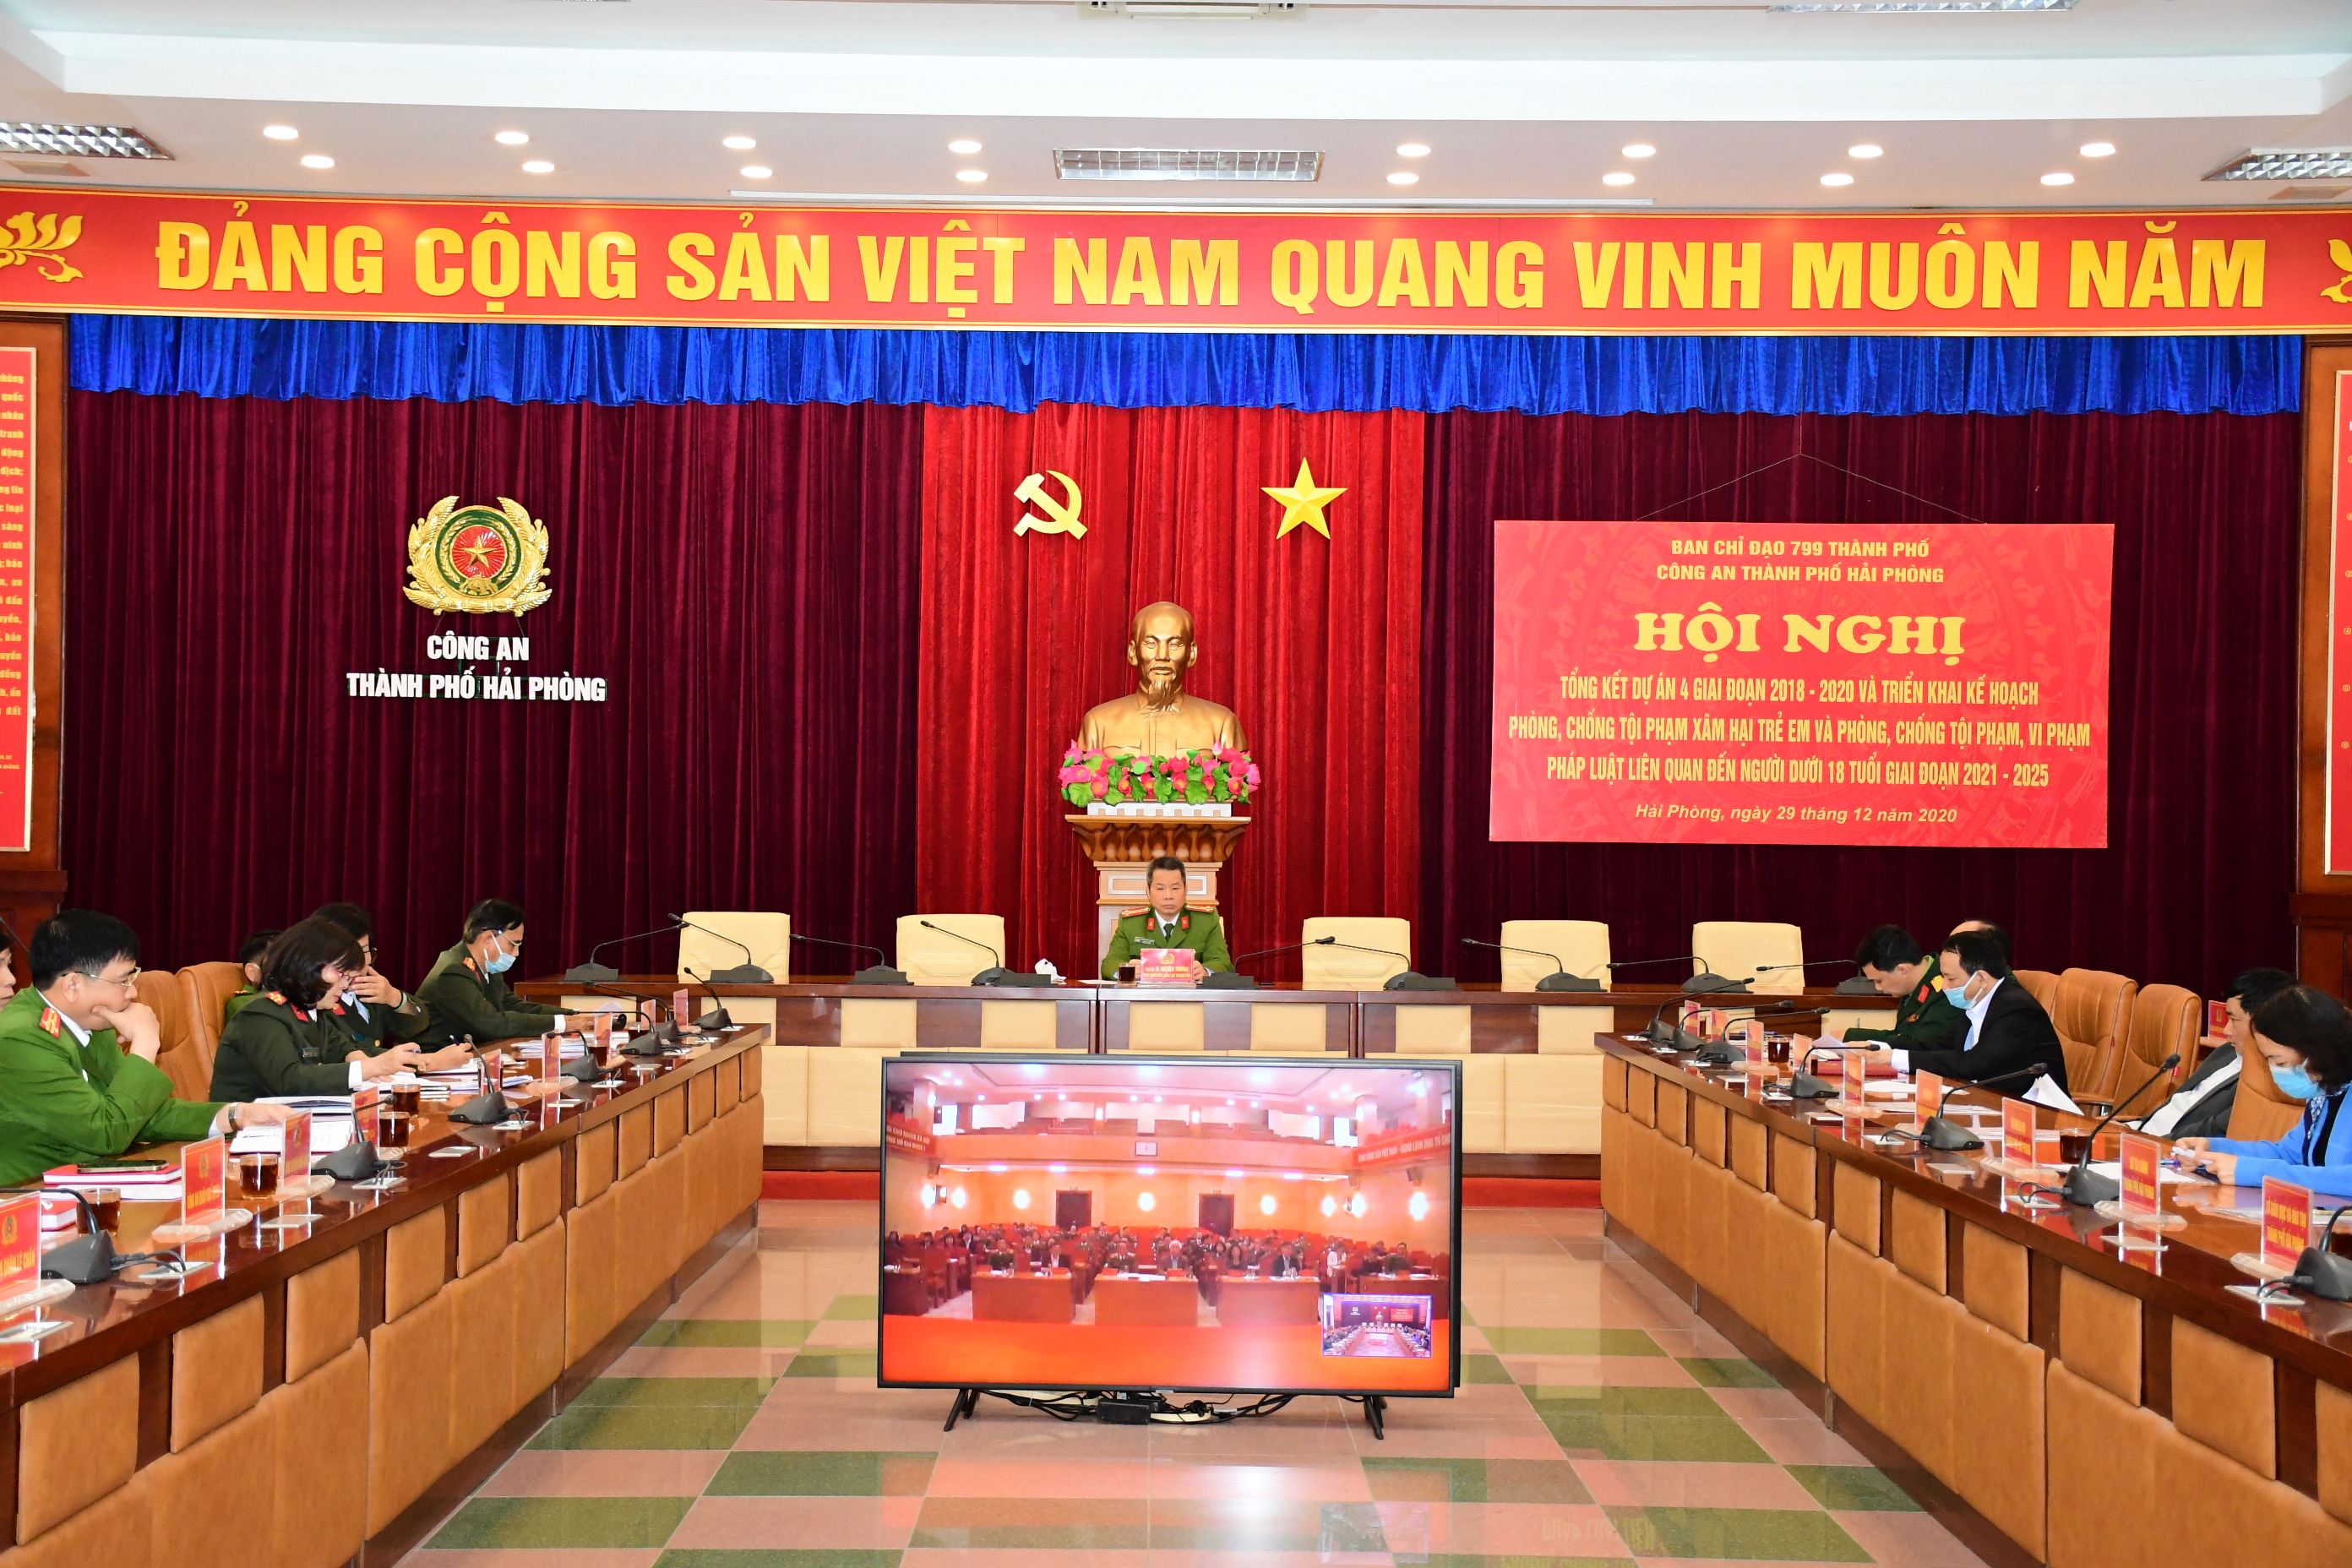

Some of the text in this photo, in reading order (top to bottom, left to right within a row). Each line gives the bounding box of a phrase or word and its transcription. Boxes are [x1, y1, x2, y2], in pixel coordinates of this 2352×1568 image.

[155, 200, 2266, 318] ĐẢNG CỘNG SẢN VIỆT NAM QUANG VINH MUÔN NĂM
[0, 373, 24, 384] hòng
[2, 392, 24, 401] quốc
[1672, 536, 1929, 558] BAN CHỈ ĐẠO 799 THÀNH PHỐ
[1657, 562, 1943, 582] CÔNG AN THÀNH PHỐ HẢI PHÒNG
[427, 630, 530, 661] CÔNG AN
[1634, 602, 1965, 666] HỘI NGHỊ
[346, 665, 607, 702] THÀNH PHỐ HẢI PHÒNG
[1560, 667, 1598, 699] TỔNG
[1602, 669, 1628, 699] KẾT
[1632, 674, 1653, 705] DỰ
[1656, 672, 1675, 700] ÁN
[1680, 678, 1689, 700] 4
[1693, 678, 1722, 700] GIAI
[1726, 678, 1766, 705] ĐOẠN
[1770, 678, 1805, 701] 2018
[1819, 679, 1854, 702] 2020
[1859, 675, 1877, 702] VÀ
[1881, 671, 1923, 703] TRIỂN
[1928, 681, 1962, 704] KHAI
[1967, 674, 1985, 704] KẾ
[1990, 682, 2038, 710] HOẠCH
[1509, 709, 2090, 751] PHÒNG, CHỐNG TỘI PHẠM XÂM HẠI TRẺ EM VÀ PHÒNG, CHỐNG TỘI PHẠM, VI PHẠM
[1548, 752, 1586, 779] PHÁP
[1590, 753, 1625, 785] LUẬT
[1629, 753, 1660, 781] LIÊN
[1665, 758, 1702, 783] QUAN
[1707, 751, 1735, 781] ĐẾN
[1740, 754, 1784, 782] NGƯỜI
[1789, 755, 1822, 783] DƯỚI
[1828, 761, 1844, 783] 18
[1849, 752, 1881, 784] TUỔI
[1886, 761, 1914, 784] GIAI
[1919, 762, 1958, 790] ĐOẠN
[1963, 763, 1996, 785] 2021
[2013, 764, 2049, 787] 2025
[1636, 803, 1957, 824] Hải Phòng, ngày 29 tháng 12 năm 2020
